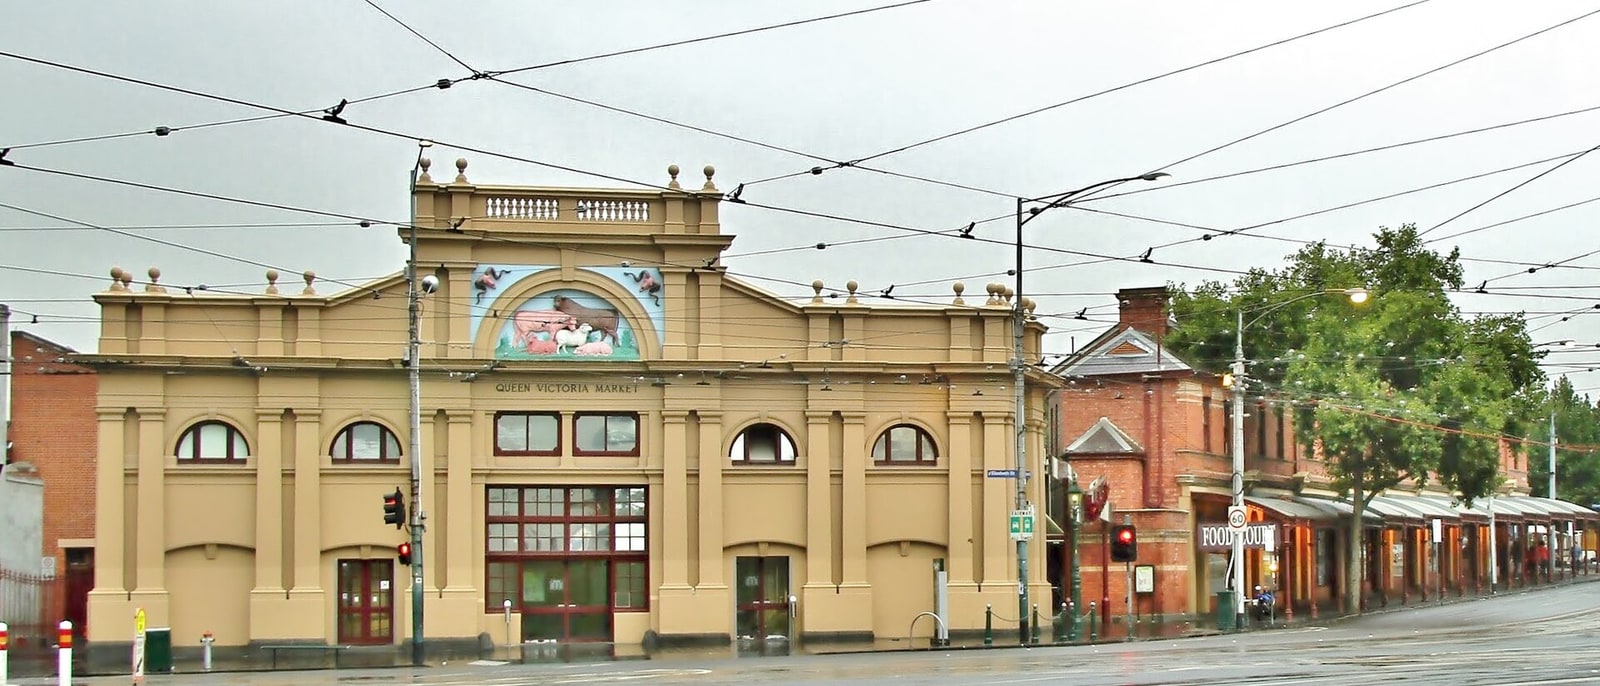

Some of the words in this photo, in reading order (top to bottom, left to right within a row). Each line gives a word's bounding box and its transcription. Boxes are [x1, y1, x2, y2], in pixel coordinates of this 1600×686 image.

[495, 383, 531, 393] QUEEN
[537, 383, 589, 393] VICTORIA
[595, 384, 639, 393] MARKET
[1232, 514, 1243, 523] 60
[1202, 527, 1233, 546] FOOD
